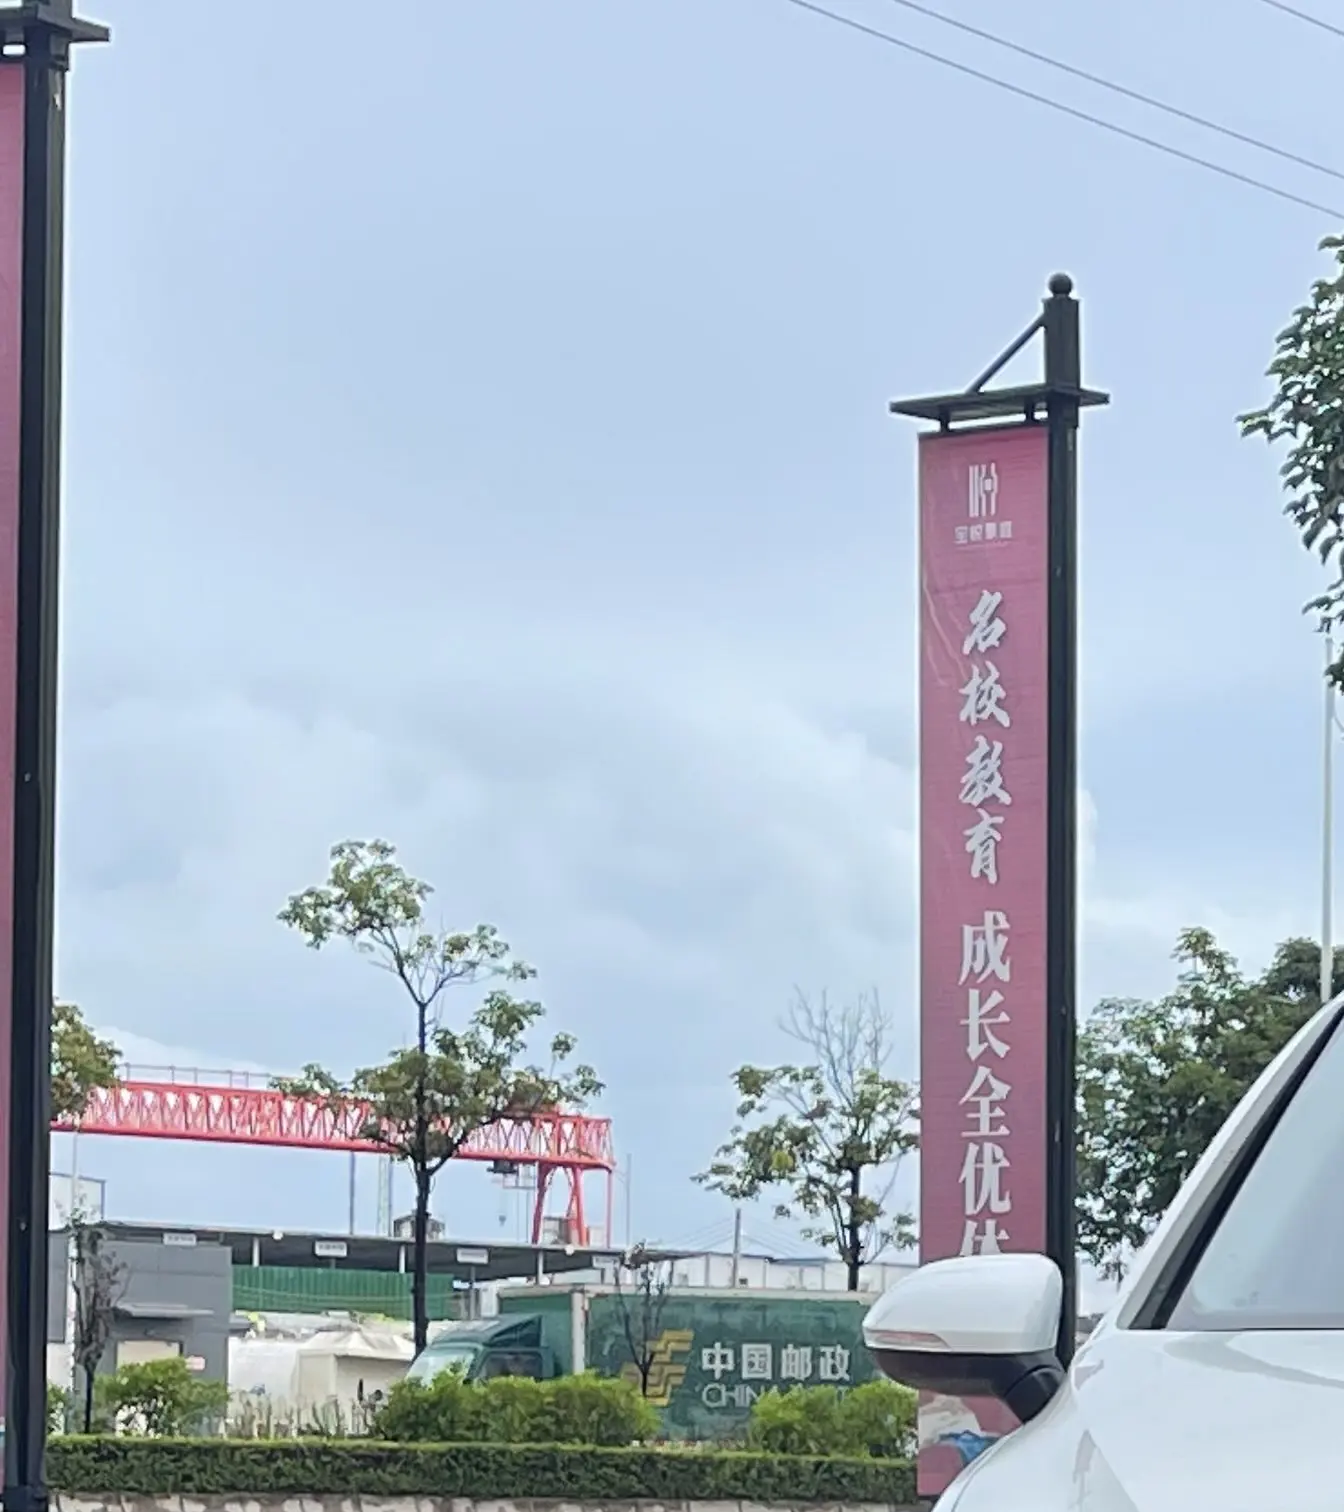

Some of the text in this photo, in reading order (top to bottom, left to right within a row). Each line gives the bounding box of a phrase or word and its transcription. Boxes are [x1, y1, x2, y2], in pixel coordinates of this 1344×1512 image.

[959, 589, 1012, 884] 名校教育
[702, 1342, 850, 1381] 中国邮政
[702, 1383, 765, 1408] CHIN
